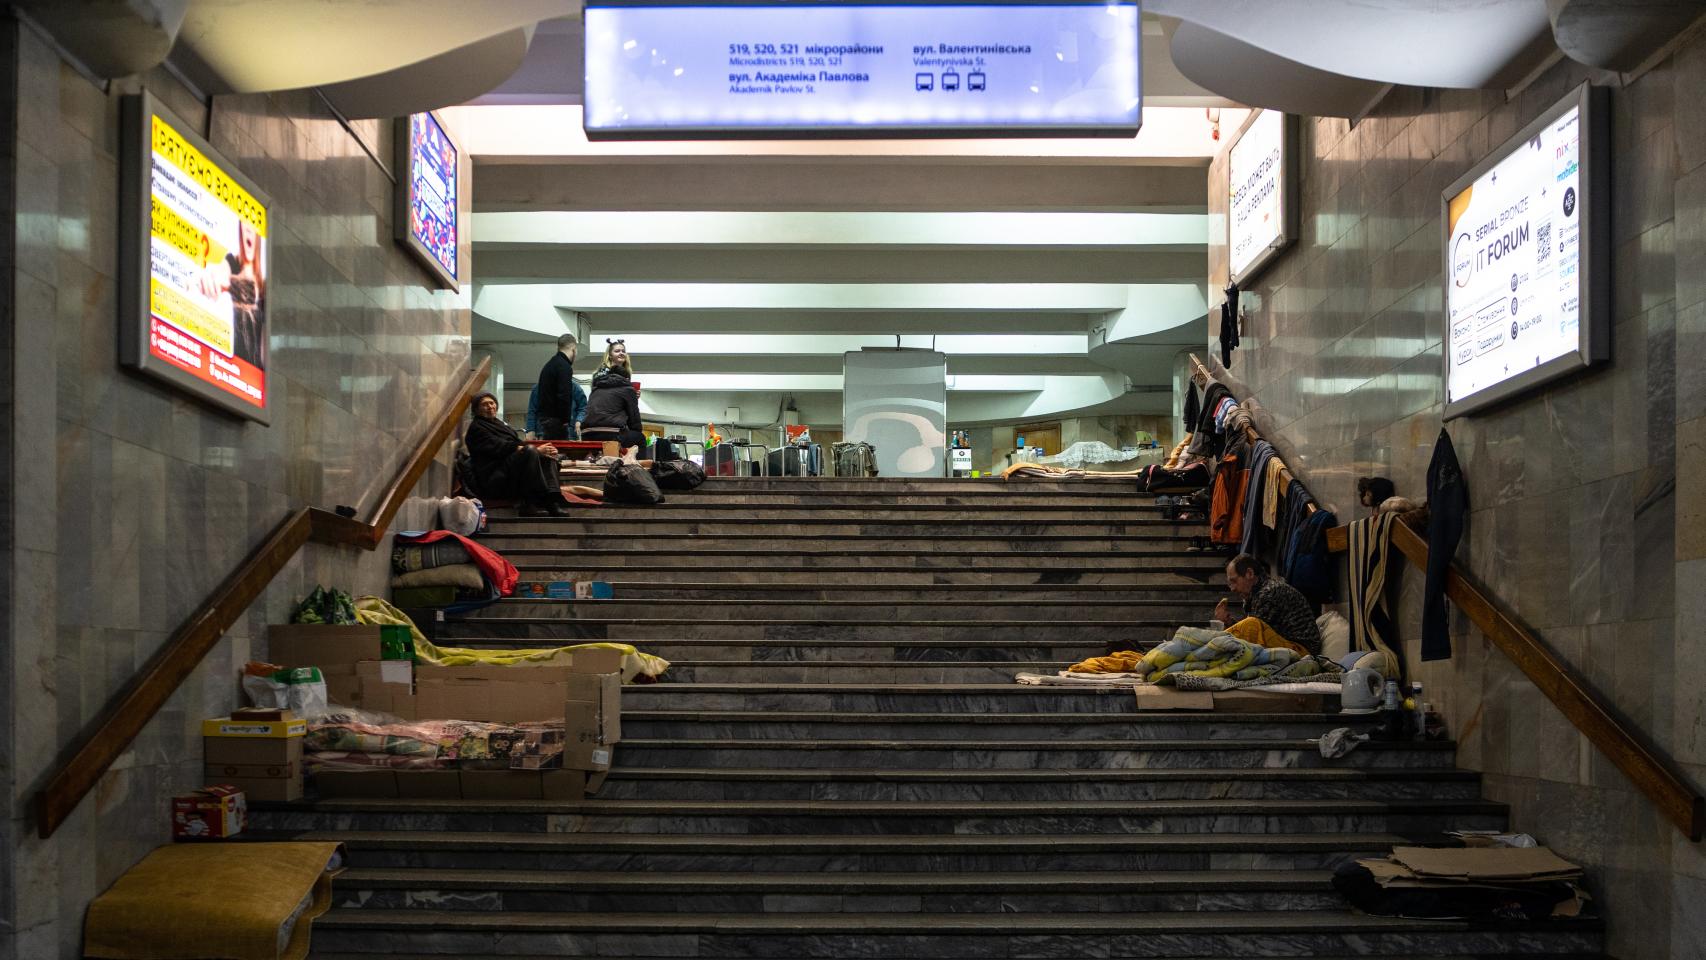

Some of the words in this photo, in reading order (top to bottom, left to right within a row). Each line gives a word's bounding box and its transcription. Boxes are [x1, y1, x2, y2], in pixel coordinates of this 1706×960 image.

[729, 44, 751, 56] 519,
[754, 44, 777, 56] 520,
[780, 44, 799, 54] 521
[805, 43, 883, 57] мікрорайони
[913, 45, 936, 56] вул.
[939, 43, 1032, 54] Валентинівська
[729, 57, 787, 66] Microdistricts
[790, 57, 805, 67] 519,
[808, 57, 825, 67] 520,
[828, 57, 842, 66] 521
[913, 57, 973, 67] Valentynivska
[976, 57, 986, 66] St.
[729, 73, 752, 83] вул.
[755, 71, 816, 83] Академіка
[819, 71, 869, 81] Павлова
[729, 85, 772, 94] Akademik
[775, 85, 802, 94] Pavlov
[805, 85, 816, 94] St.
[160, 130, 212, 189] РЯТУЄМО
[217, 176, 262, 225] ВОЛОССЯ
[1475, 217, 1499, 242] SERIAL
[1500, 196, 1528, 226] BRONZE
[1476, 248, 1485, 273] IT
[1487, 220, 1529, 266] FORUM
